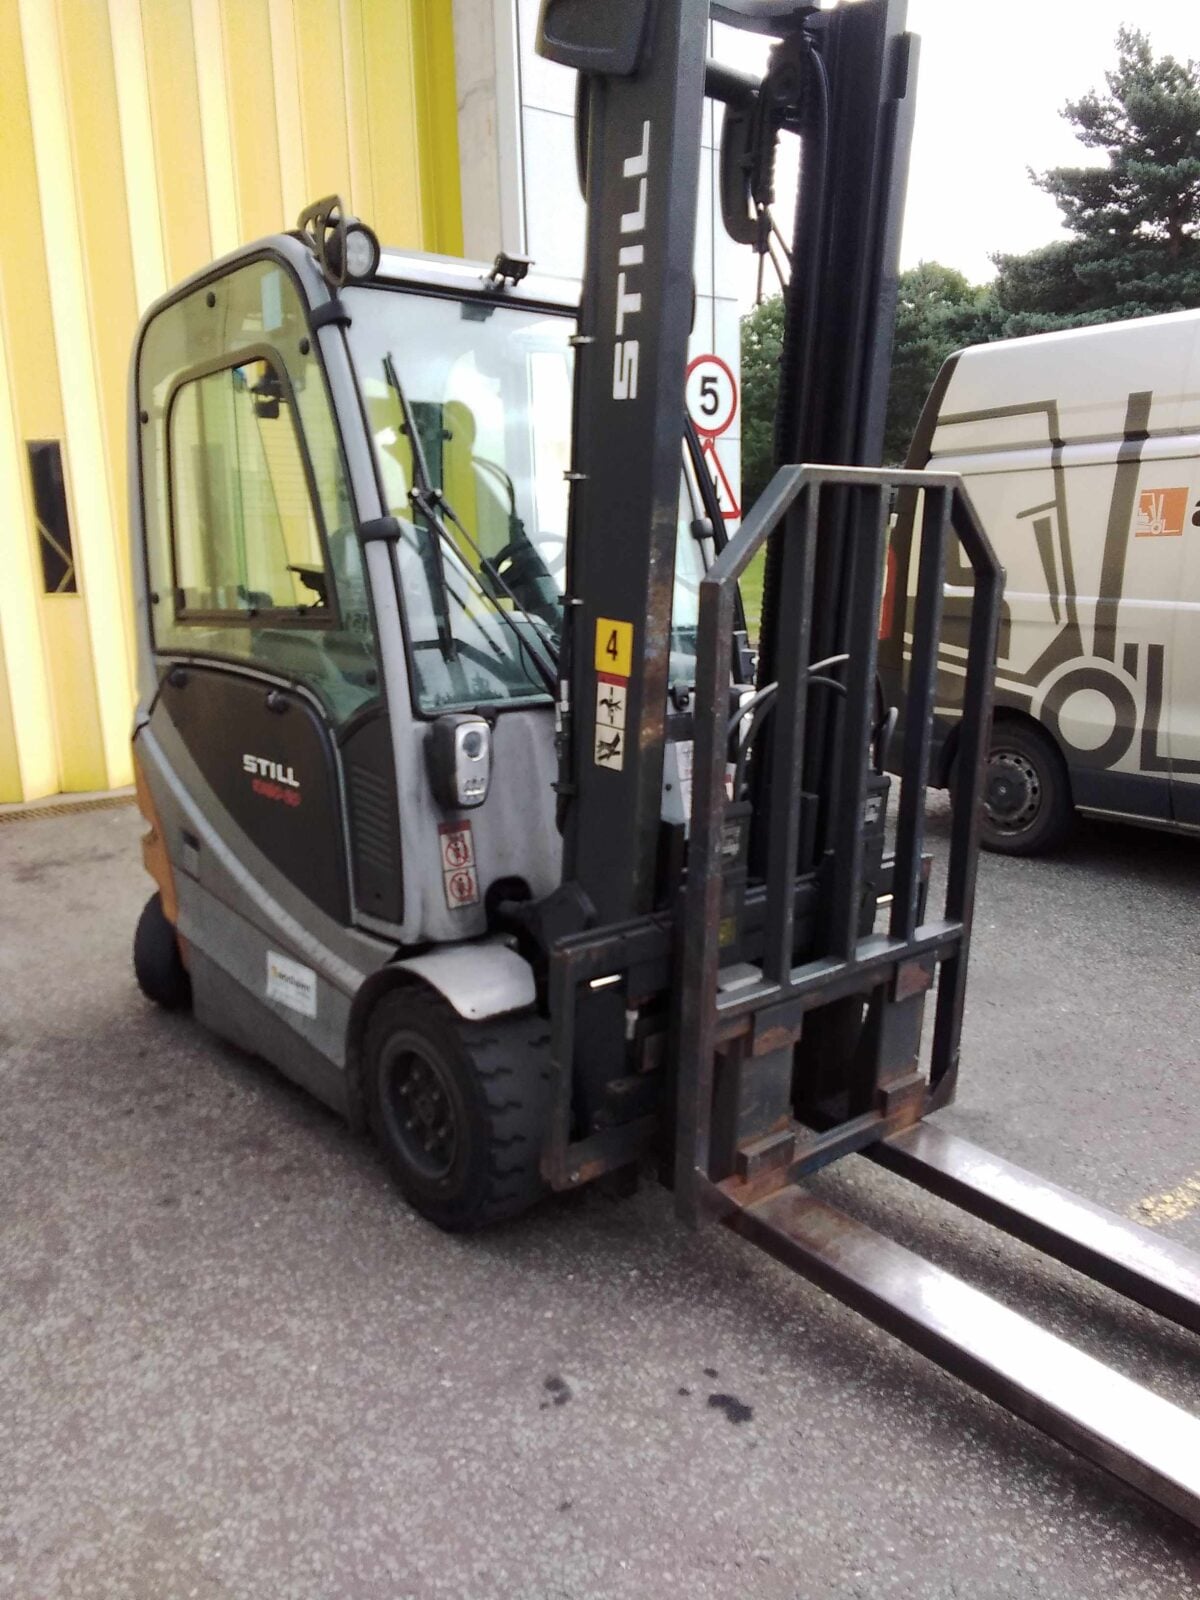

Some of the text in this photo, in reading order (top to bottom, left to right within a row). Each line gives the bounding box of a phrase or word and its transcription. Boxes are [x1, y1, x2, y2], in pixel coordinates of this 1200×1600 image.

[612, 120, 651, 400] STILL
[700, 375, 720, 416] 5
[606, 629, 618, 661] 4
[243, 754, 300, 788] STILL
